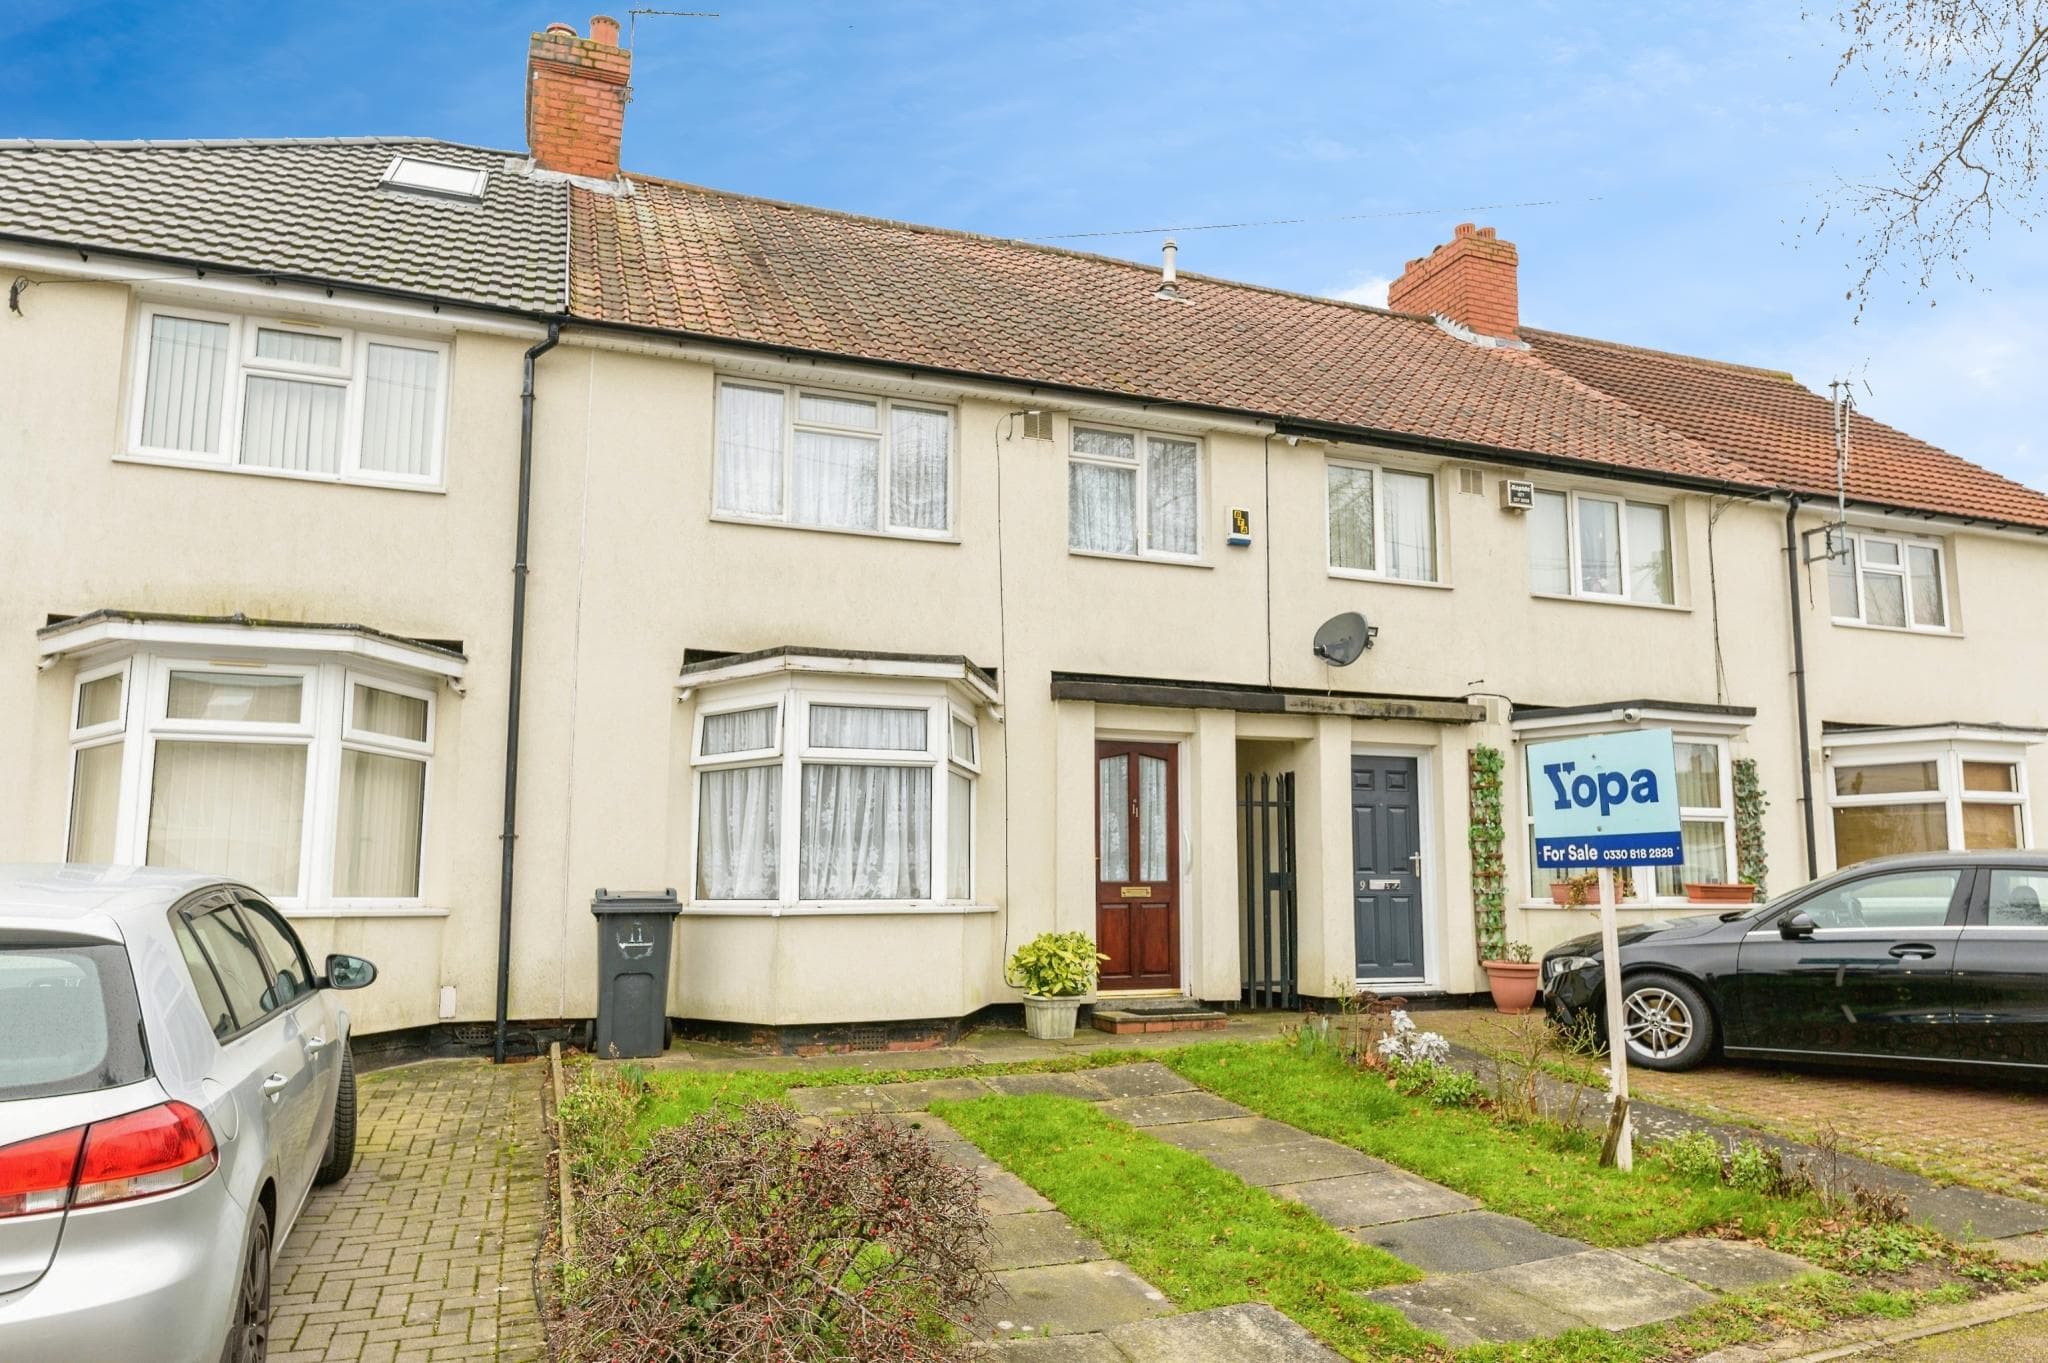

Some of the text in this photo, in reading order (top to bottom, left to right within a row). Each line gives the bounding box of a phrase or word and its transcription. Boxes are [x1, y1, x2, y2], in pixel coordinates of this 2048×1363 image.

[1543, 761, 1659, 816] Yopa
[1543, 843, 1674, 862] For Sale 0330 818 2828
[1359, 880, 1366, 891] 9
